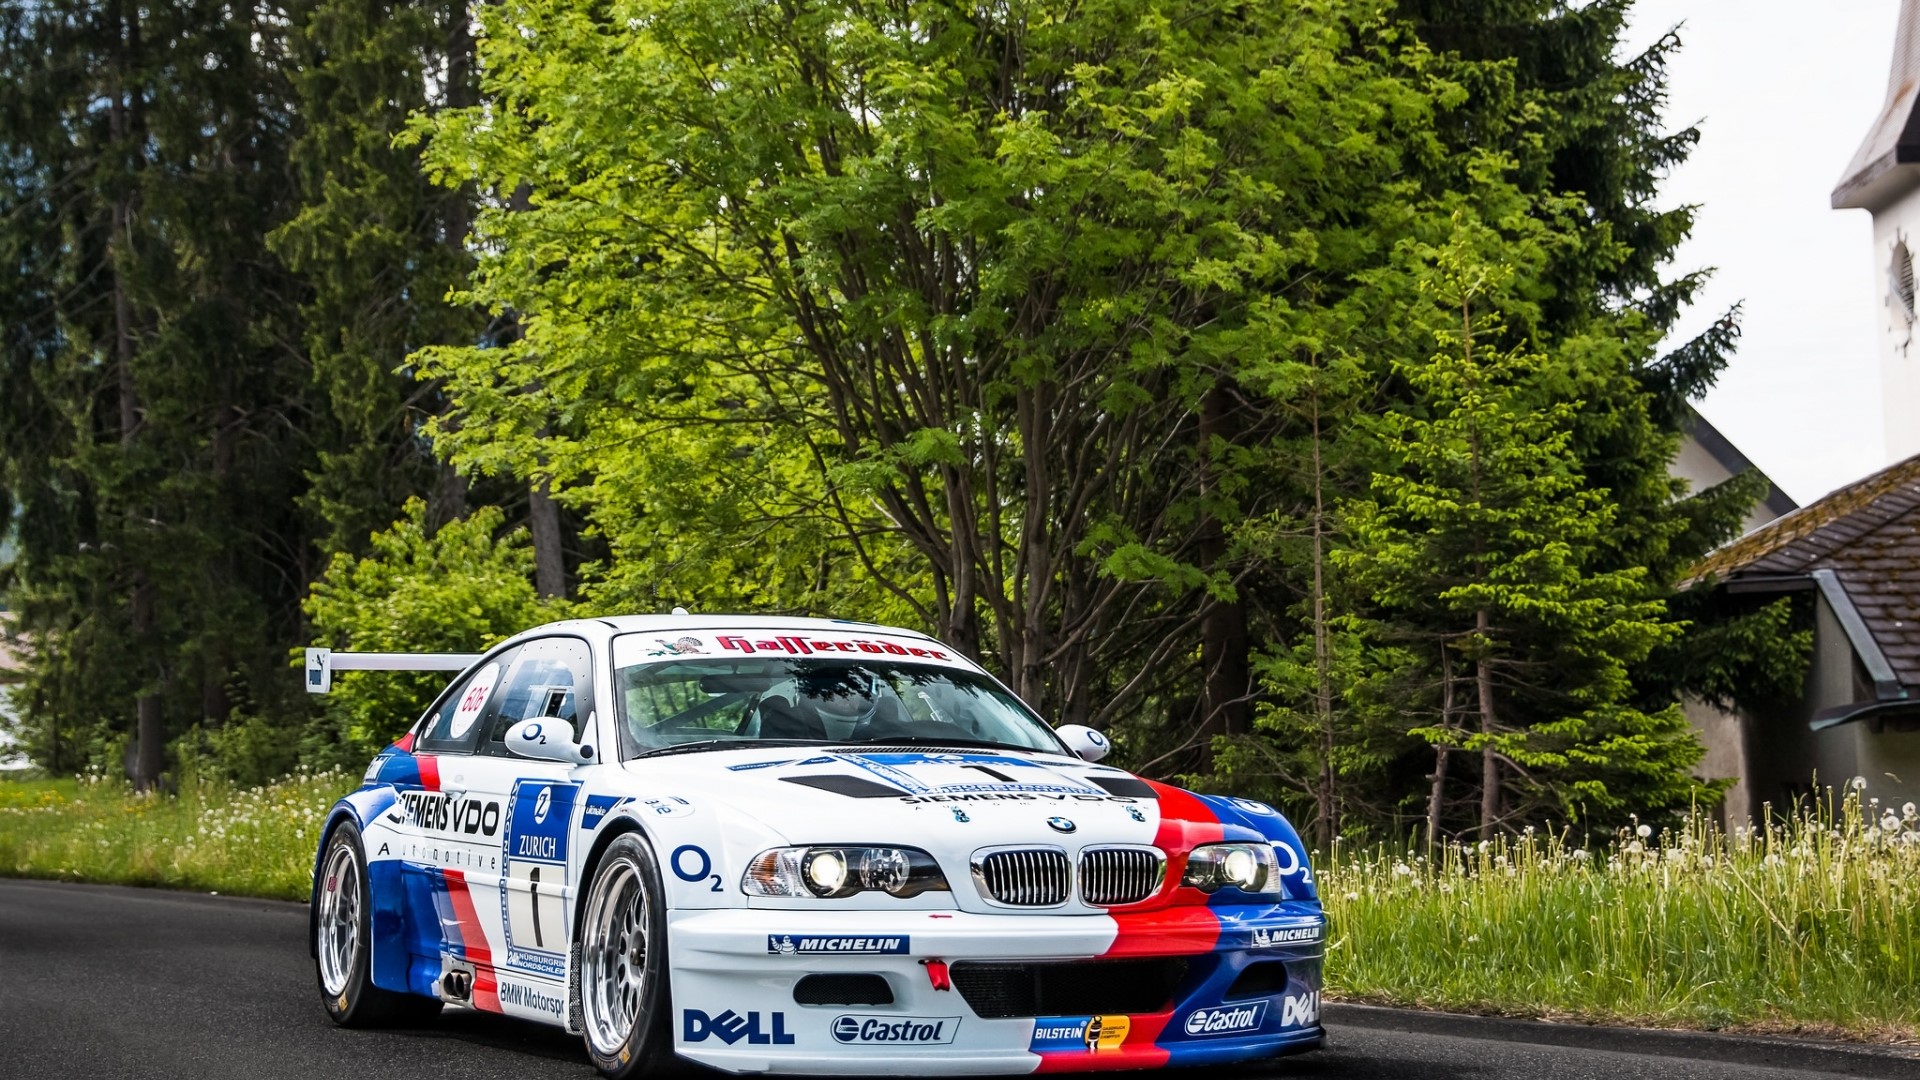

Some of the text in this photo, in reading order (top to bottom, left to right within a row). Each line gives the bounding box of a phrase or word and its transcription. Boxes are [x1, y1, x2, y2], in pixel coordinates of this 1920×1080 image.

[462, 687, 488, 711] 606
[522, 723, 546, 745] O2
[900, 793, 1138, 804] SIEMENS VDO
[387, 793, 500, 836] SIEMENS VDO
[519, 835, 556, 858] ZURICH
[670, 844, 724, 892] O2
[530, 867, 543, 947] 1
[799, 938, 900, 950] MICHELIN
[1271, 927, 1320, 942] MICHELIN
[500, 982, 523, 1005] BMW
[683, 1009, 795, 1045] DELL
[1203, 1005, 1258, 1031] Castrol
[860, 1020, 944, 1041] Castrol
[1035, 1027, 1083, 1039] BILSTEIN
